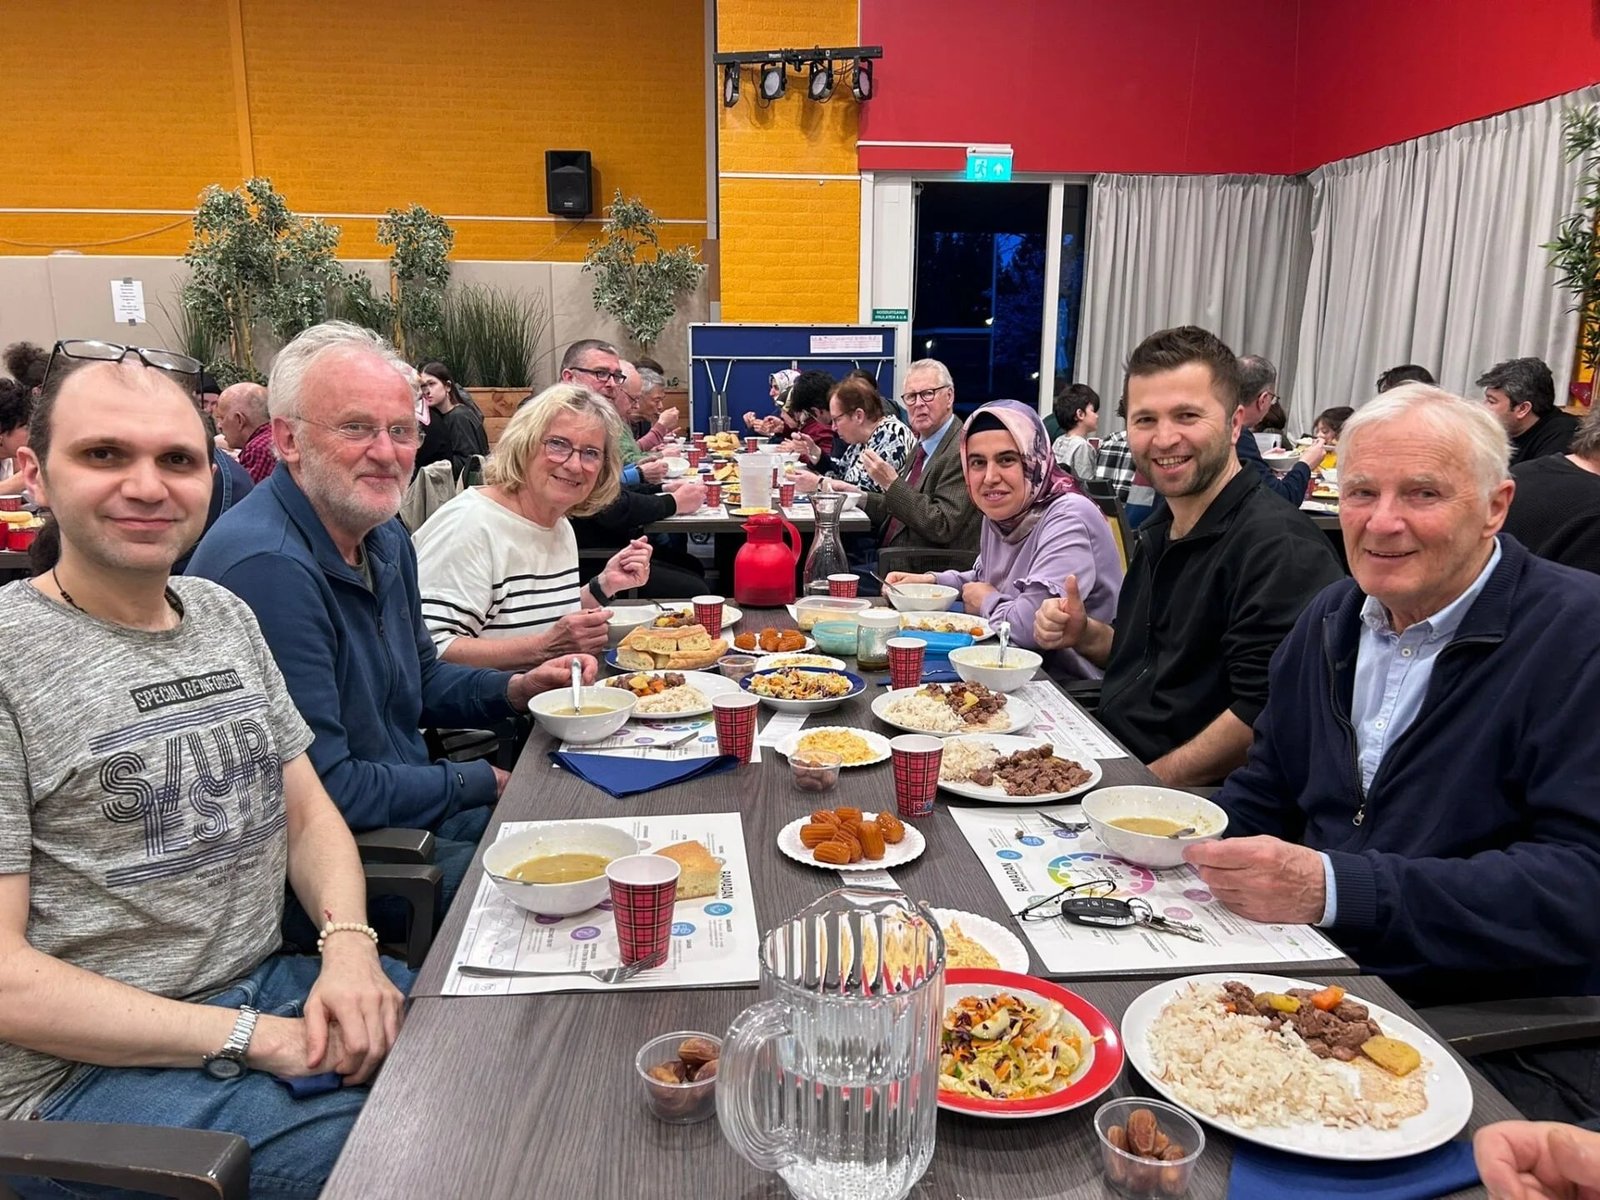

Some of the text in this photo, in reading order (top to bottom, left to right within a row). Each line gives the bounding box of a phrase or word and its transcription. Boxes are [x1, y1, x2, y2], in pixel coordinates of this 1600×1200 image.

[135, 671, 241, 708] SPECIAL REINFORCED
[720, 870, 734, 899] RAMADAN
[1000, 862, 1028, 892] RAMADAN
